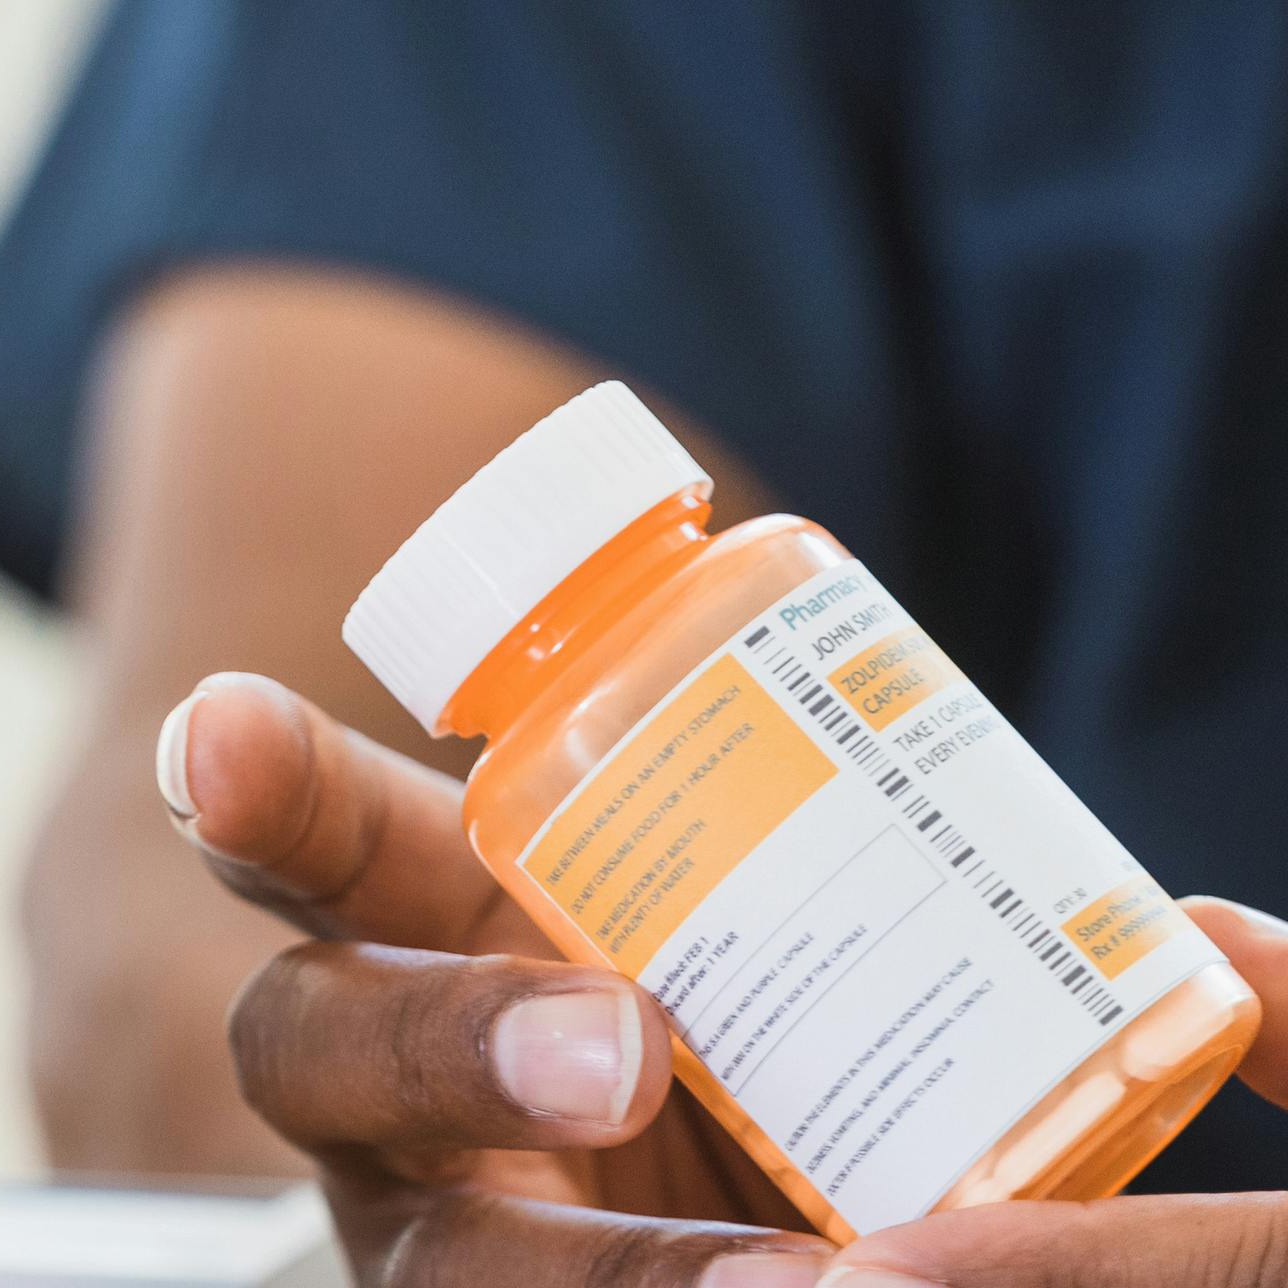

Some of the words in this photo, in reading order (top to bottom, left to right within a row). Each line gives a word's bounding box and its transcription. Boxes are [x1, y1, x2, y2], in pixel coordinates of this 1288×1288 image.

[779, 572, 867, 631] Pharmacy
[810, 619, 857, 660] JOHN
[852, 600, 891, 631] SMITH
[841, 642, 907, 694] ZOLPIDEM
[862, 667, 923, 715] CAPSULE
[893, 719, 933, 754] TAKE
[929, 714, 942, 729] 1
[915, 737, 959, 775] EVERY
[711, 931, 738, 957] YEAR
[1076, 914, 1111, 941] Store
[1090, 939, 1112, 961] Rx
